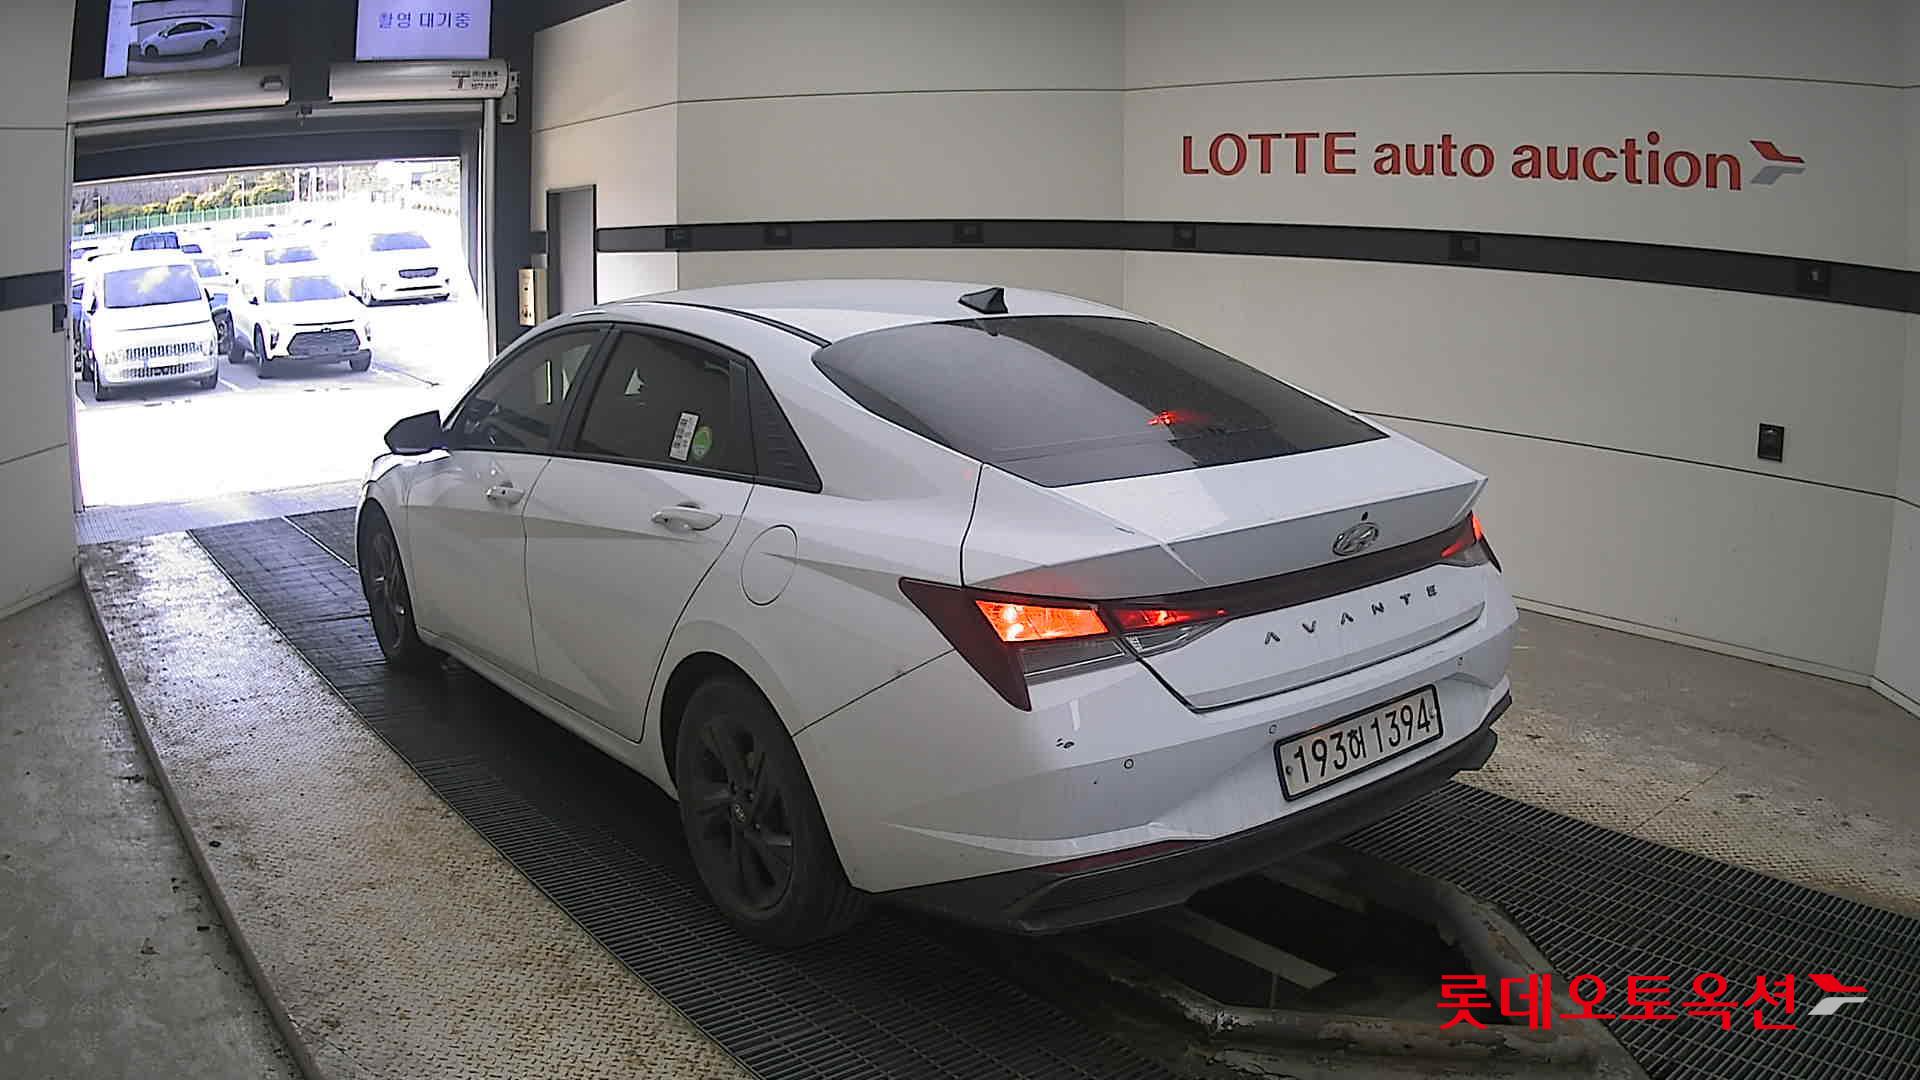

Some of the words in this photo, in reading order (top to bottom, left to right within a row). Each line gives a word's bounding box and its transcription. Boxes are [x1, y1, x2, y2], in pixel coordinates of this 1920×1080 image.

[420, 11, 472, 29] 대기중
[1183, 132, 1357, 176] LOTTE
[1373, 134, 1495, 178] auto
[1512, 131, 1743, 191] auction
[1264, 584, 1438, 645] AVANTE
[1294, 725, 1366, 783] 193허
[1371, 698, 1430, 753] 1394
